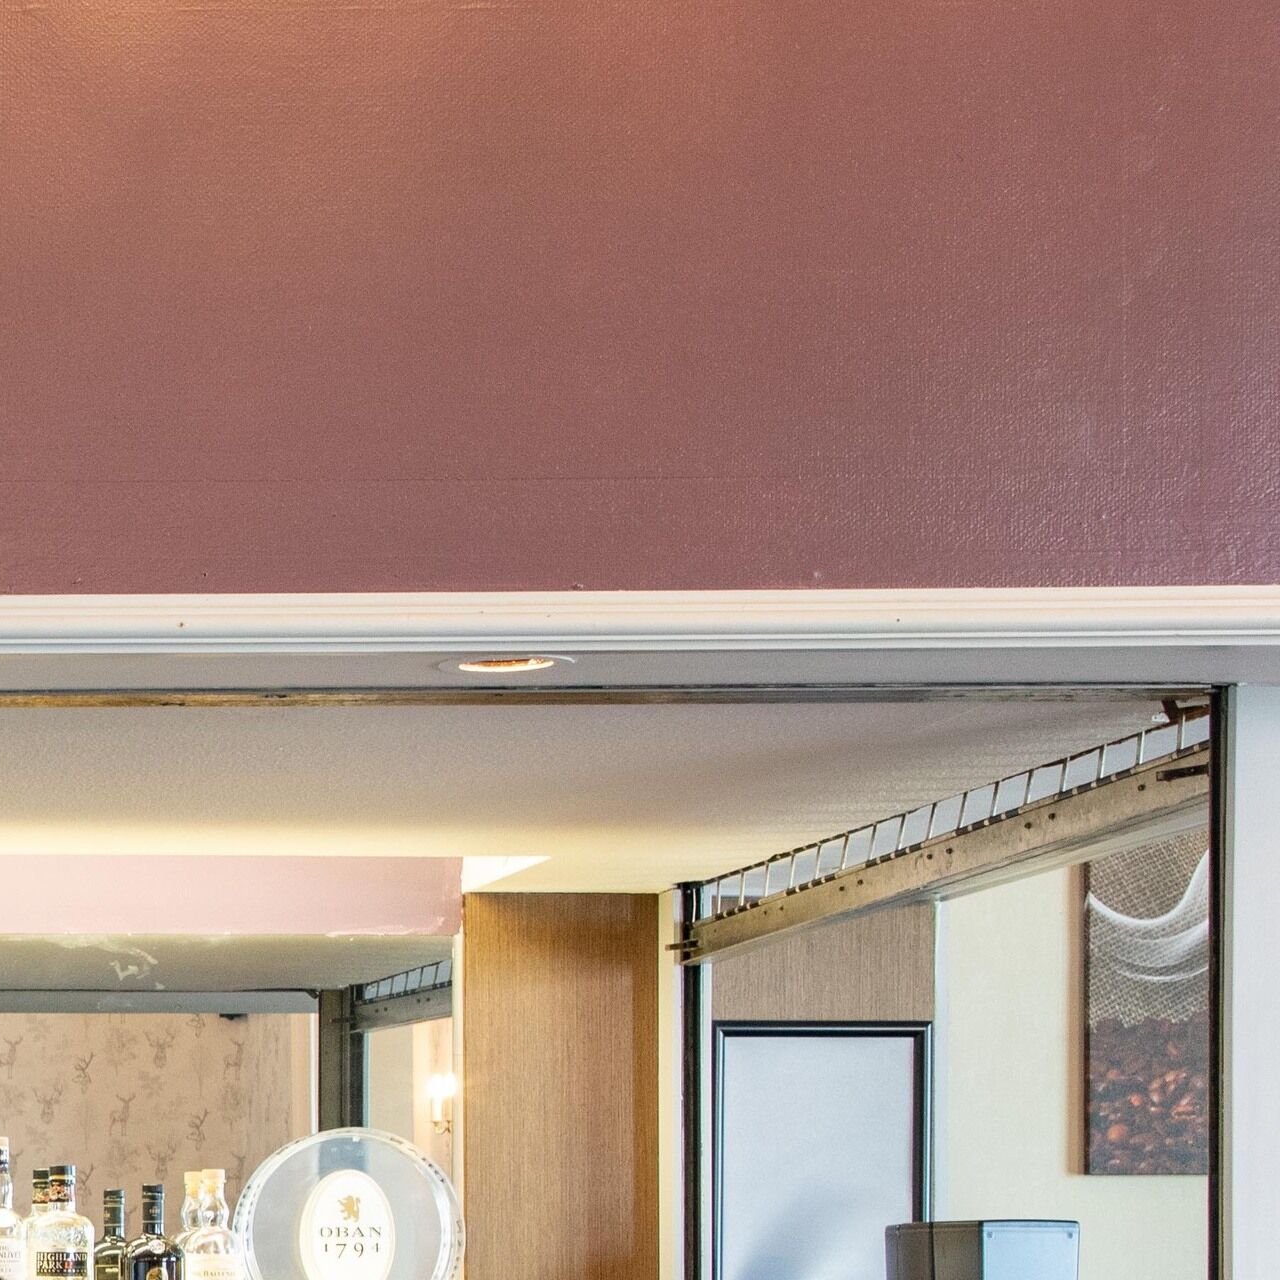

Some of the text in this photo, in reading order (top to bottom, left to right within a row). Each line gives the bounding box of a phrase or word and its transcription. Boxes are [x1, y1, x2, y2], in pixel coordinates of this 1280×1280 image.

[320, 1226, 382, 1238] OBAN
[324, 1243, 380, 1258] 1794
[37, 1252, 87, 1262] HIGHLAND
